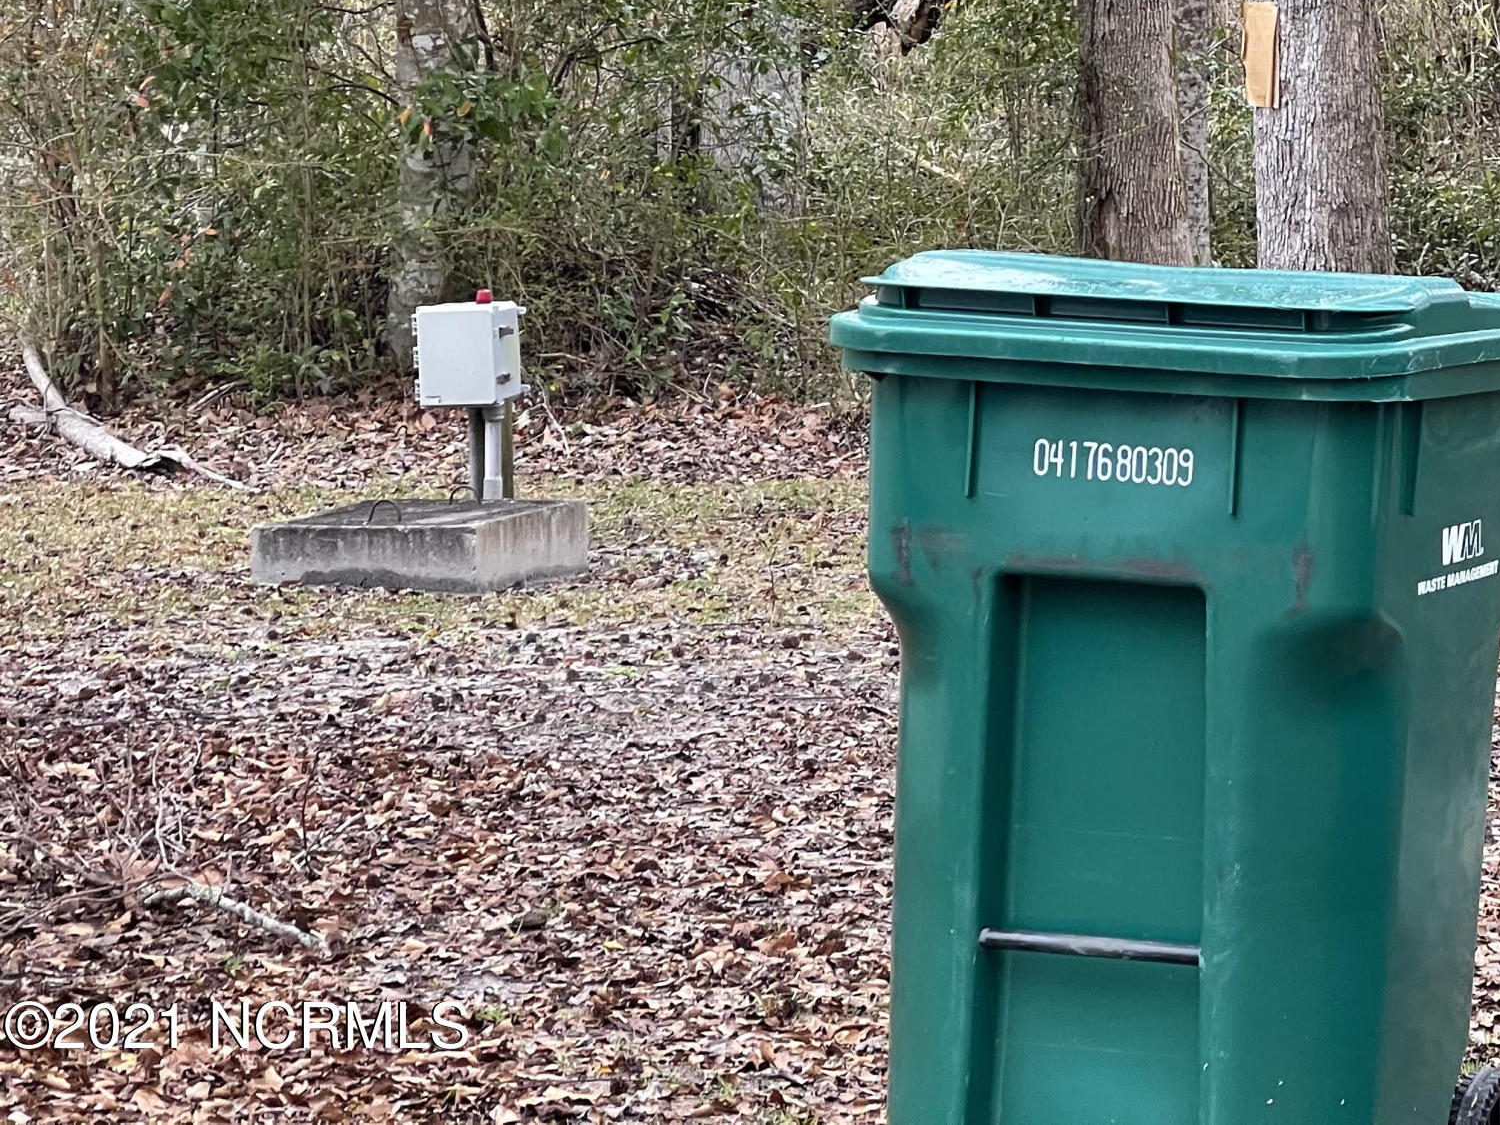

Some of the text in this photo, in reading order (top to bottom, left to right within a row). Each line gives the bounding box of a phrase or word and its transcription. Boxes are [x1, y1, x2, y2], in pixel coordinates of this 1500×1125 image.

[1033, 438, 1194, 487] 0417680309
[1417, 559, 1499, 596] WASTE MANAGEMENT
